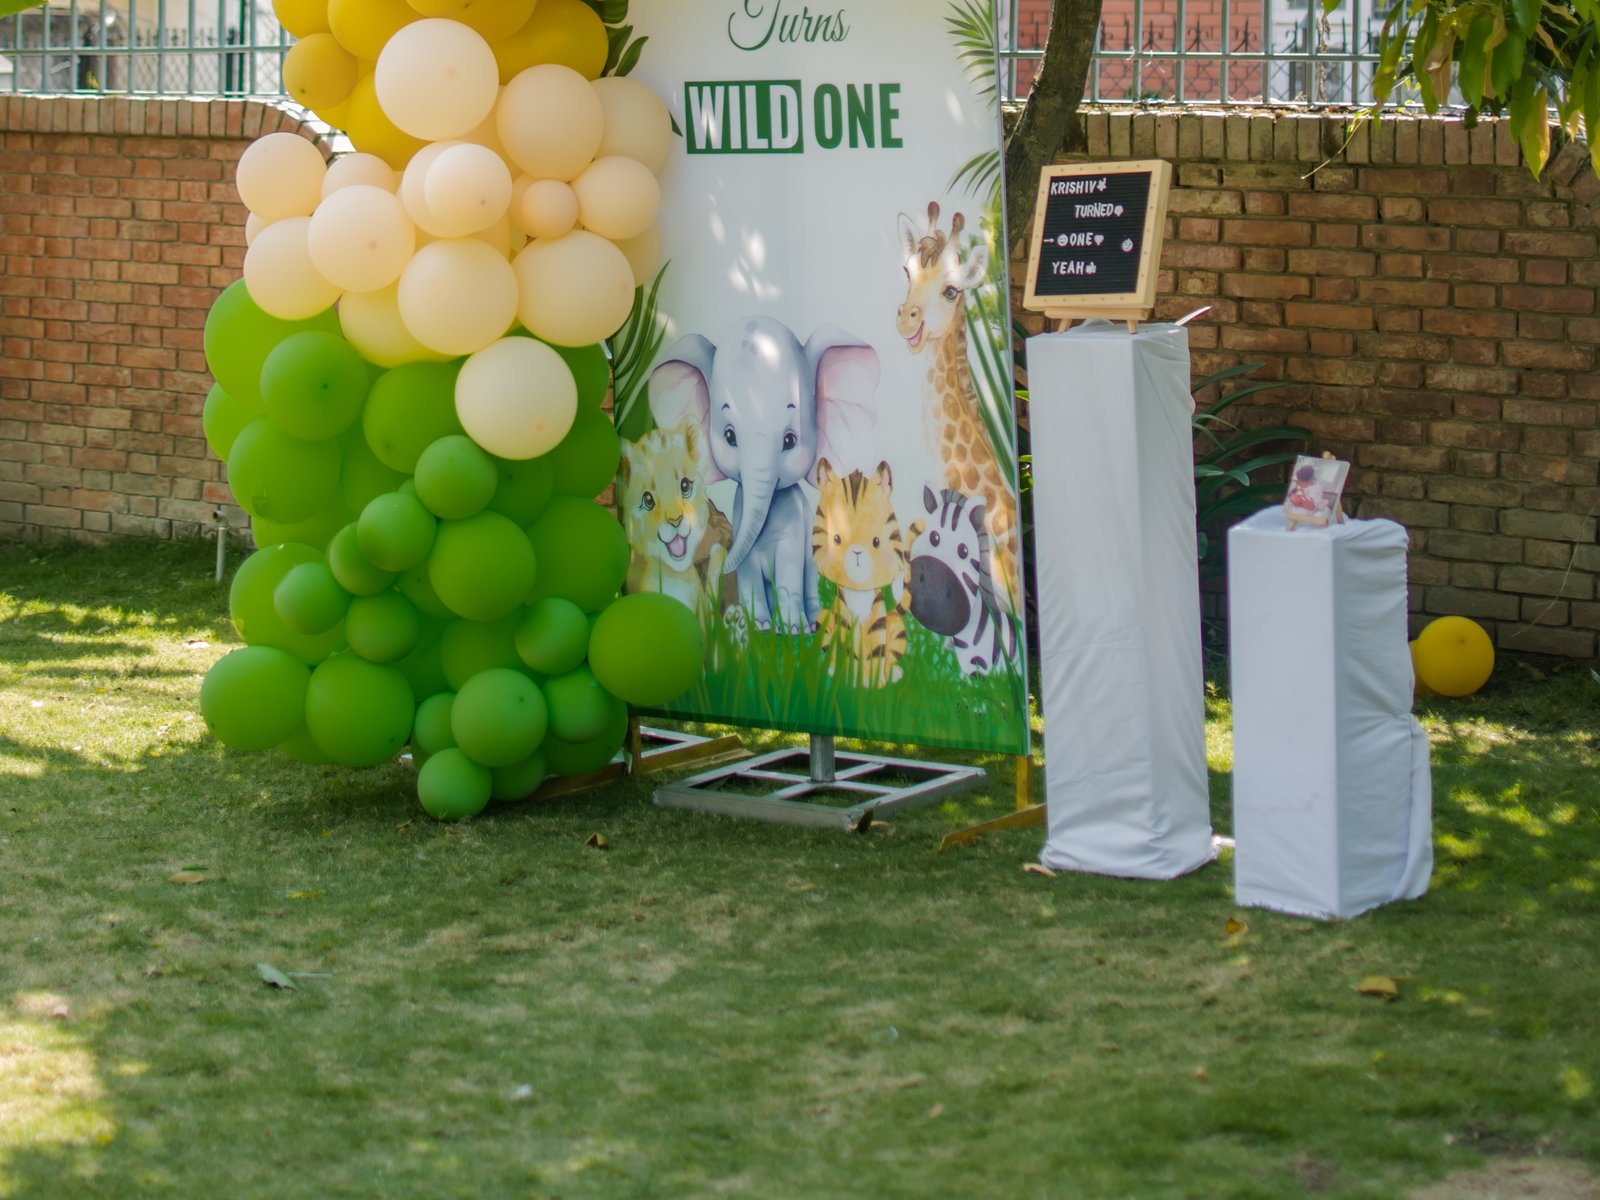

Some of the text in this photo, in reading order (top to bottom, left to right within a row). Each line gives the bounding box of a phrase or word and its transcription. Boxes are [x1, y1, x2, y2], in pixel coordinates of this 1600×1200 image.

[688, 82, 904, 151] WILD ONE
[1050, 180, 1097, 195] KRISHIV
[1075, 203, 1114, 218] TURNED
[1069, 232, 1094, 246] ONE
[1052, 261, 1085, 275] YEAH
